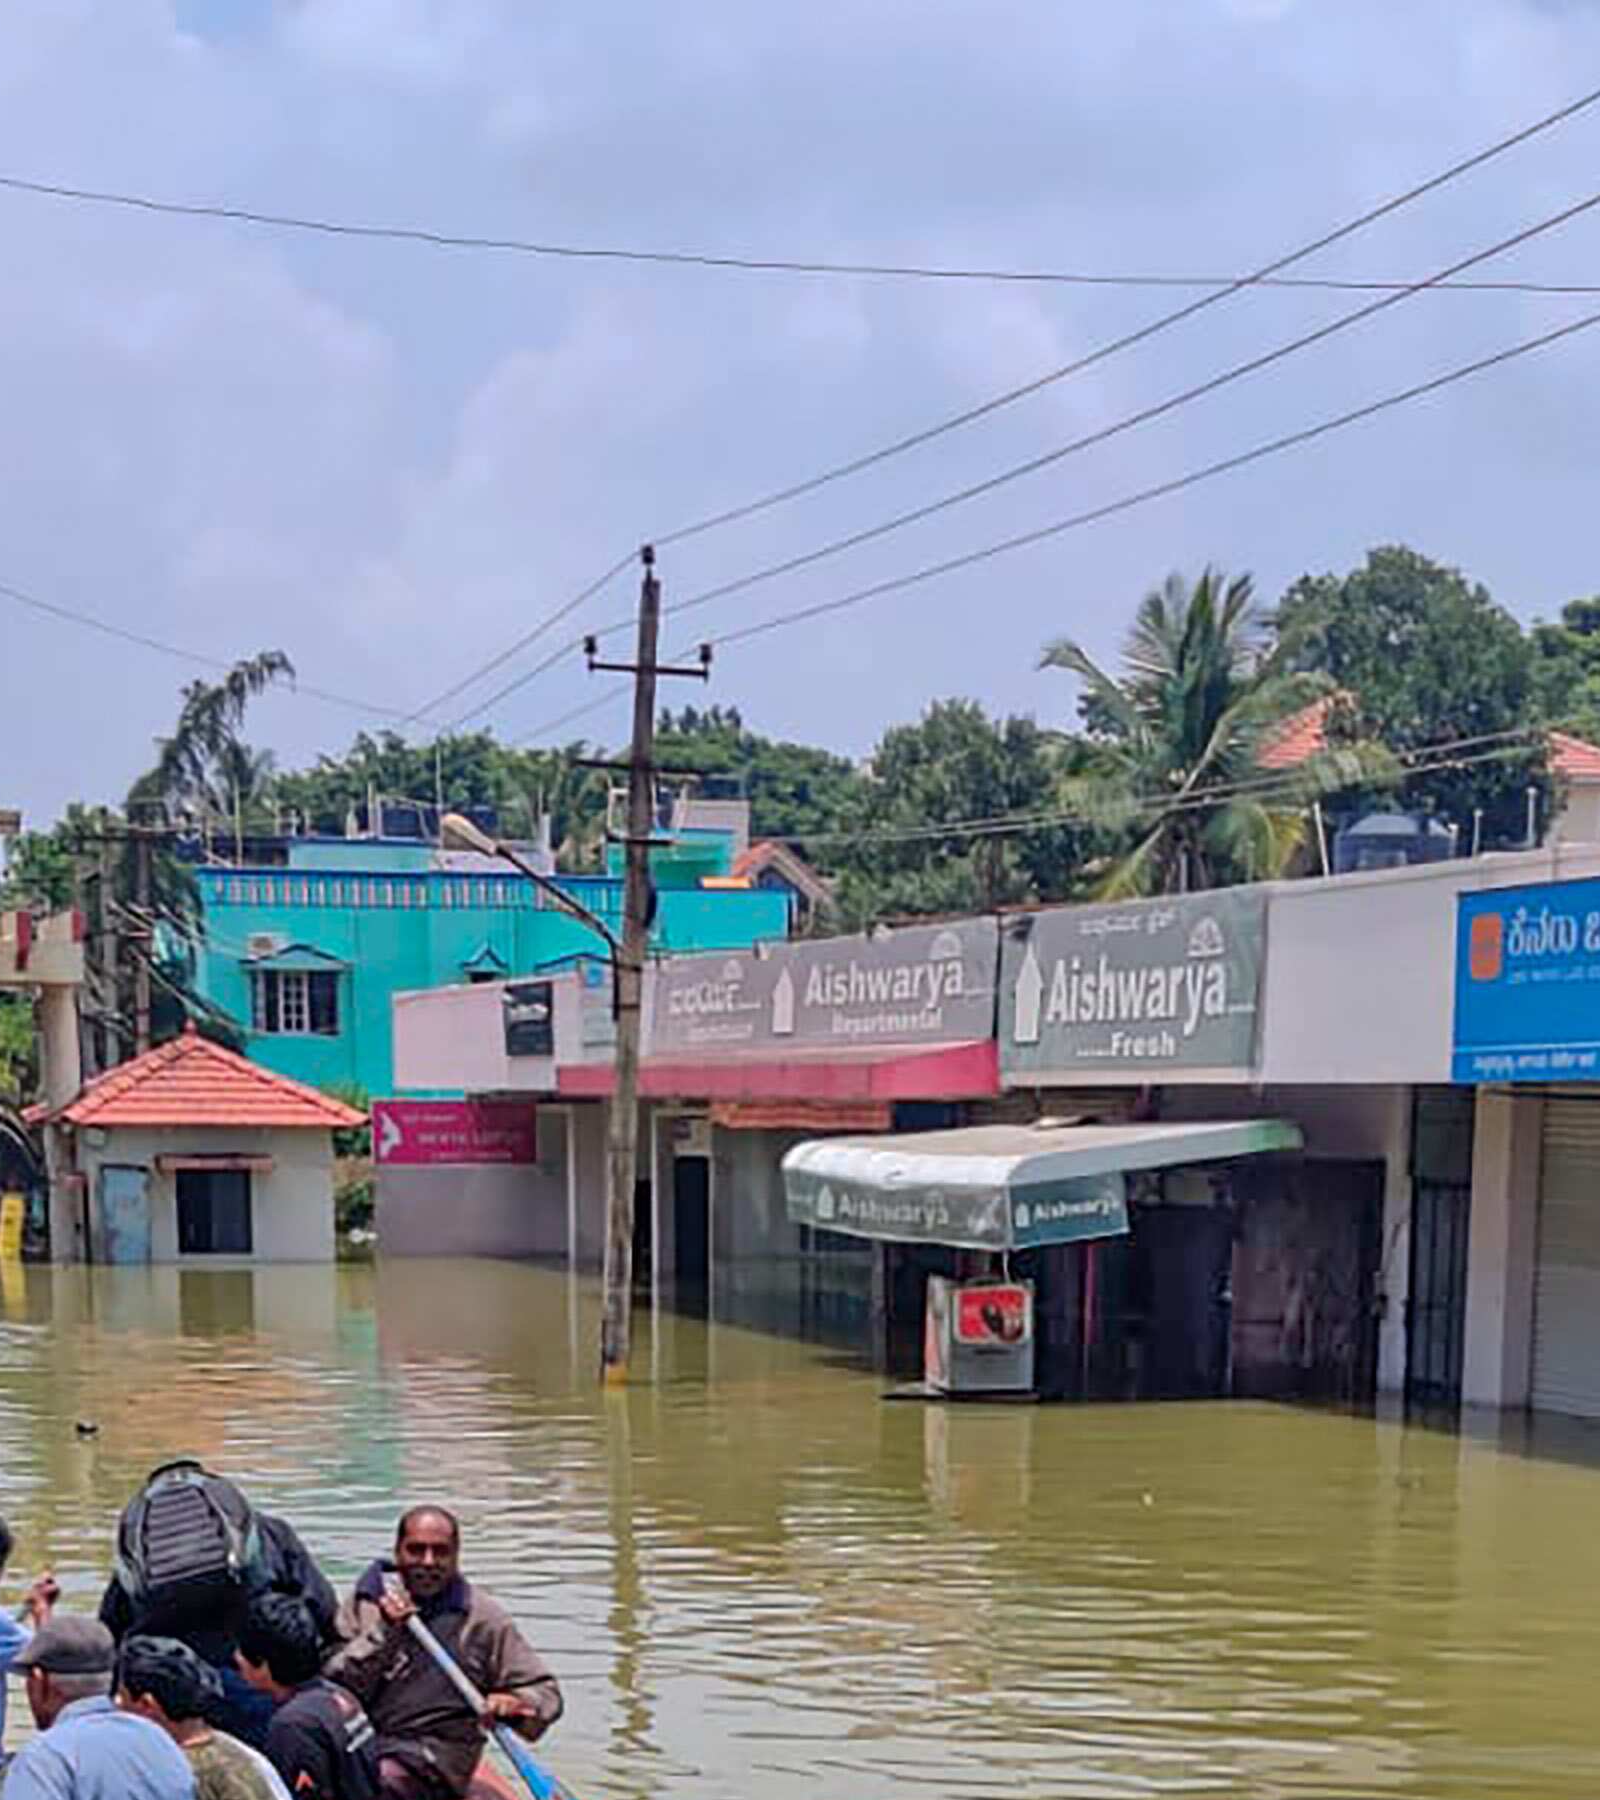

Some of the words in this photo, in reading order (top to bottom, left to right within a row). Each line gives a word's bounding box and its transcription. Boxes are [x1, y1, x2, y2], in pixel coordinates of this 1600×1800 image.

[804, 959, 963, 1008] Aishwarya
[1047, 954, 1225, 1036] Aishwarya
[832, 1007, 942, 1035] Departmental
[838, 1193, 949, 1229] Aishwarya
